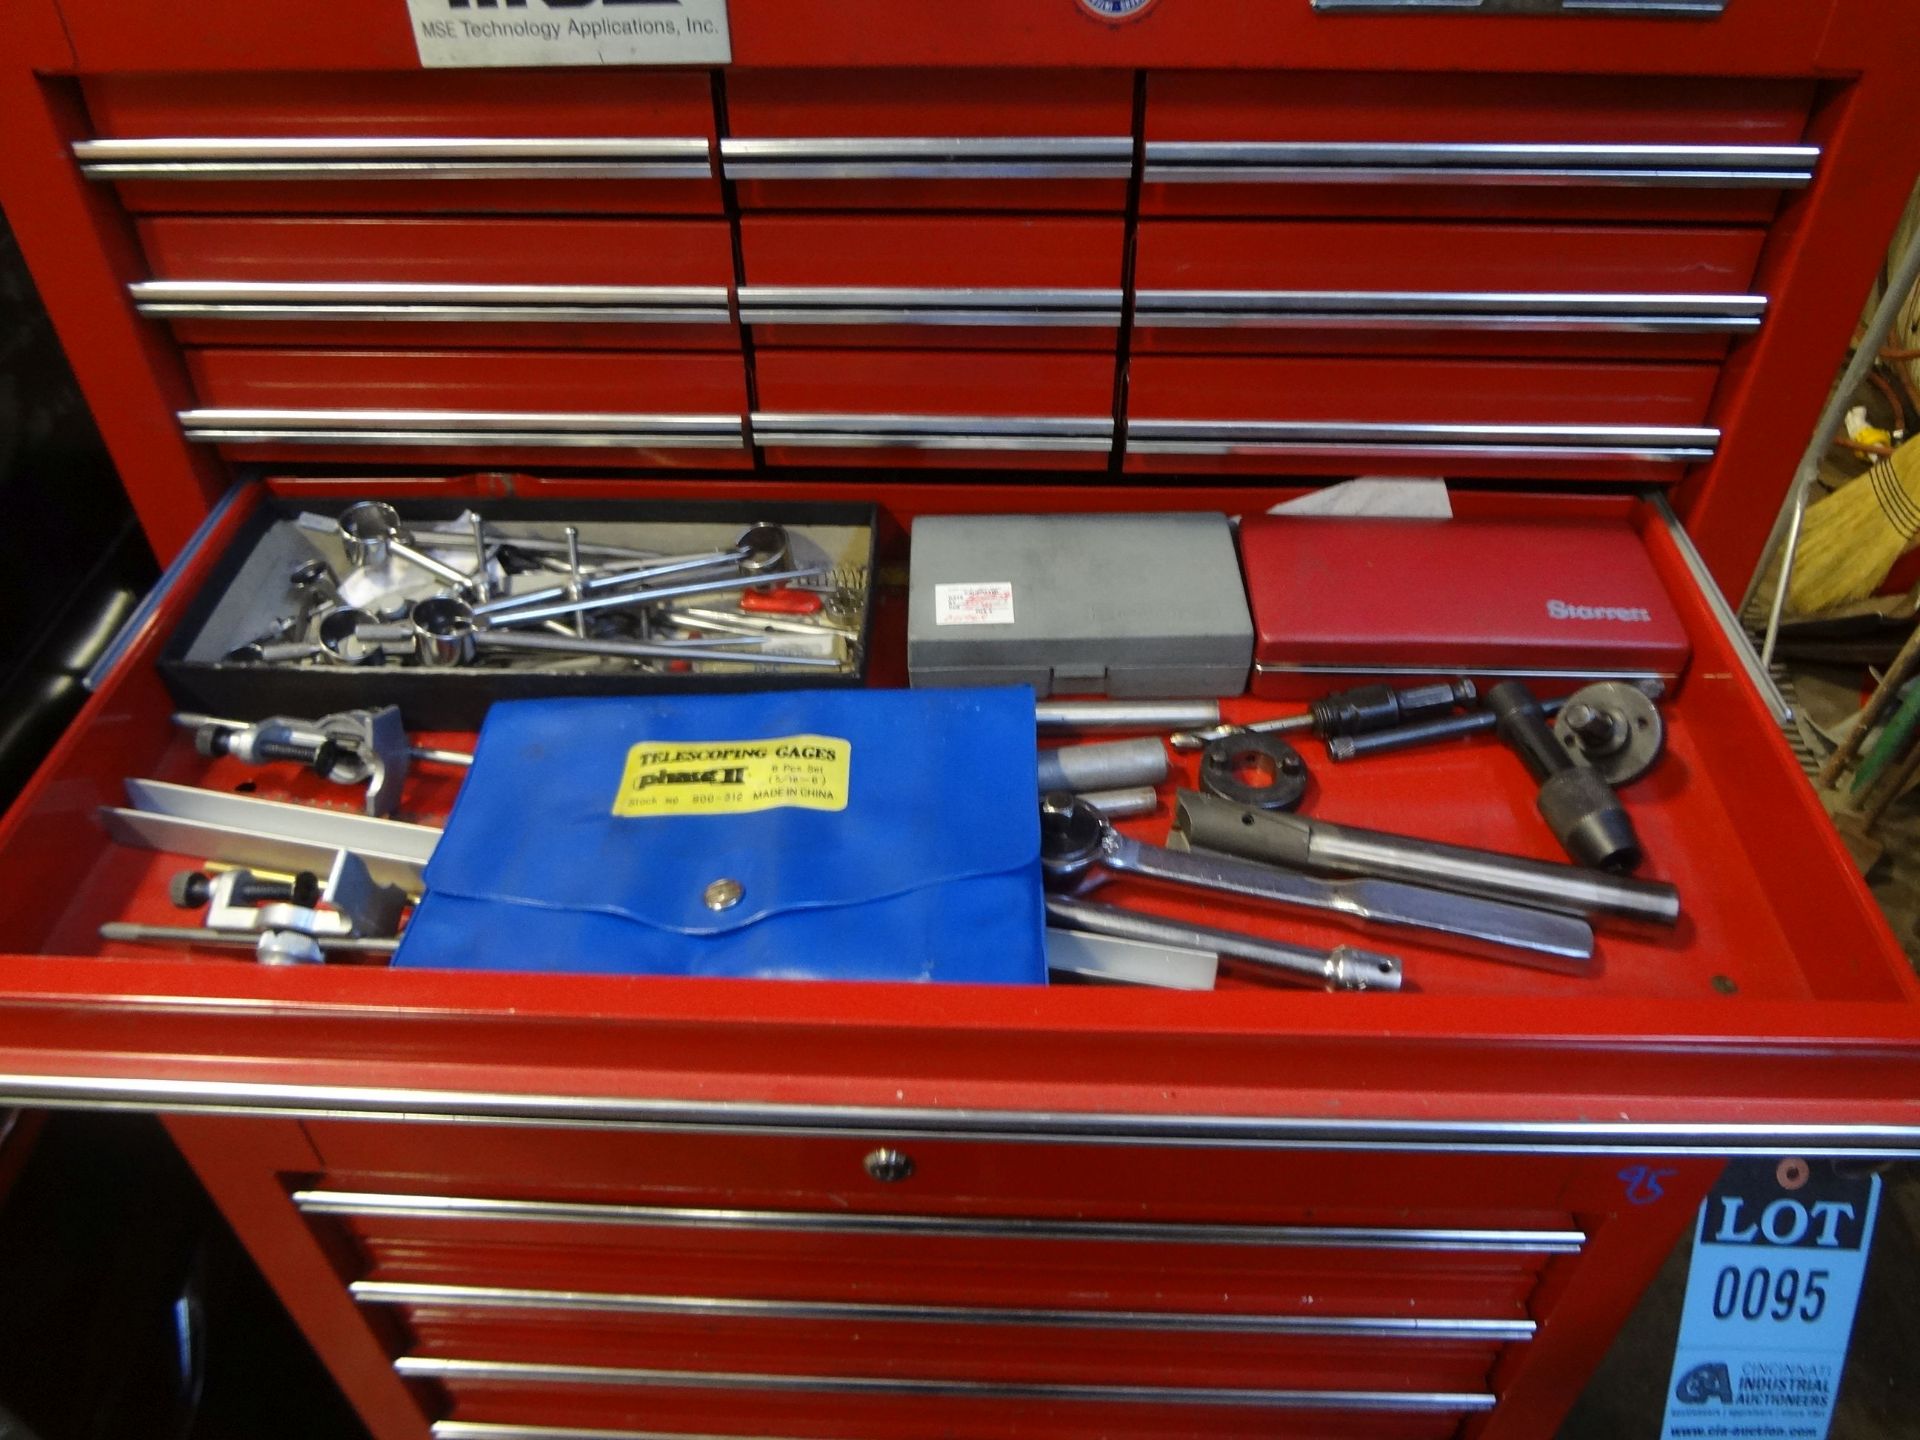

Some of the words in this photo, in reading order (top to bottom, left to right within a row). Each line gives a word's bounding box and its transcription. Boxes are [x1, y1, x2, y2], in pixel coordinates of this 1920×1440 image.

[422, 21, 457, 38] MSE
[463, 19, 561, 40] Technology
[567, 18, 680, 40] Applications,
[686, 16, 720, 35] Inc.
[639, 748, 767, 767] TELESCOPING
[775, 744, 837, 762] GAGES
[753, 787, 784, 800] MADE
[786, 787, 798, 797] IN
[800, 787, 835, 800] CHINA
[1715, 1196, 1855, 1246] LOT
[1712, 1265, 1830, 1322] 0095
[1740, 1361, 1832, 1378] CINCINNATI
[1738, 1377, 1830, 1393] INDUSTRIAL
[1734, 1394, 1829, 1407] AUCTIONEERS
